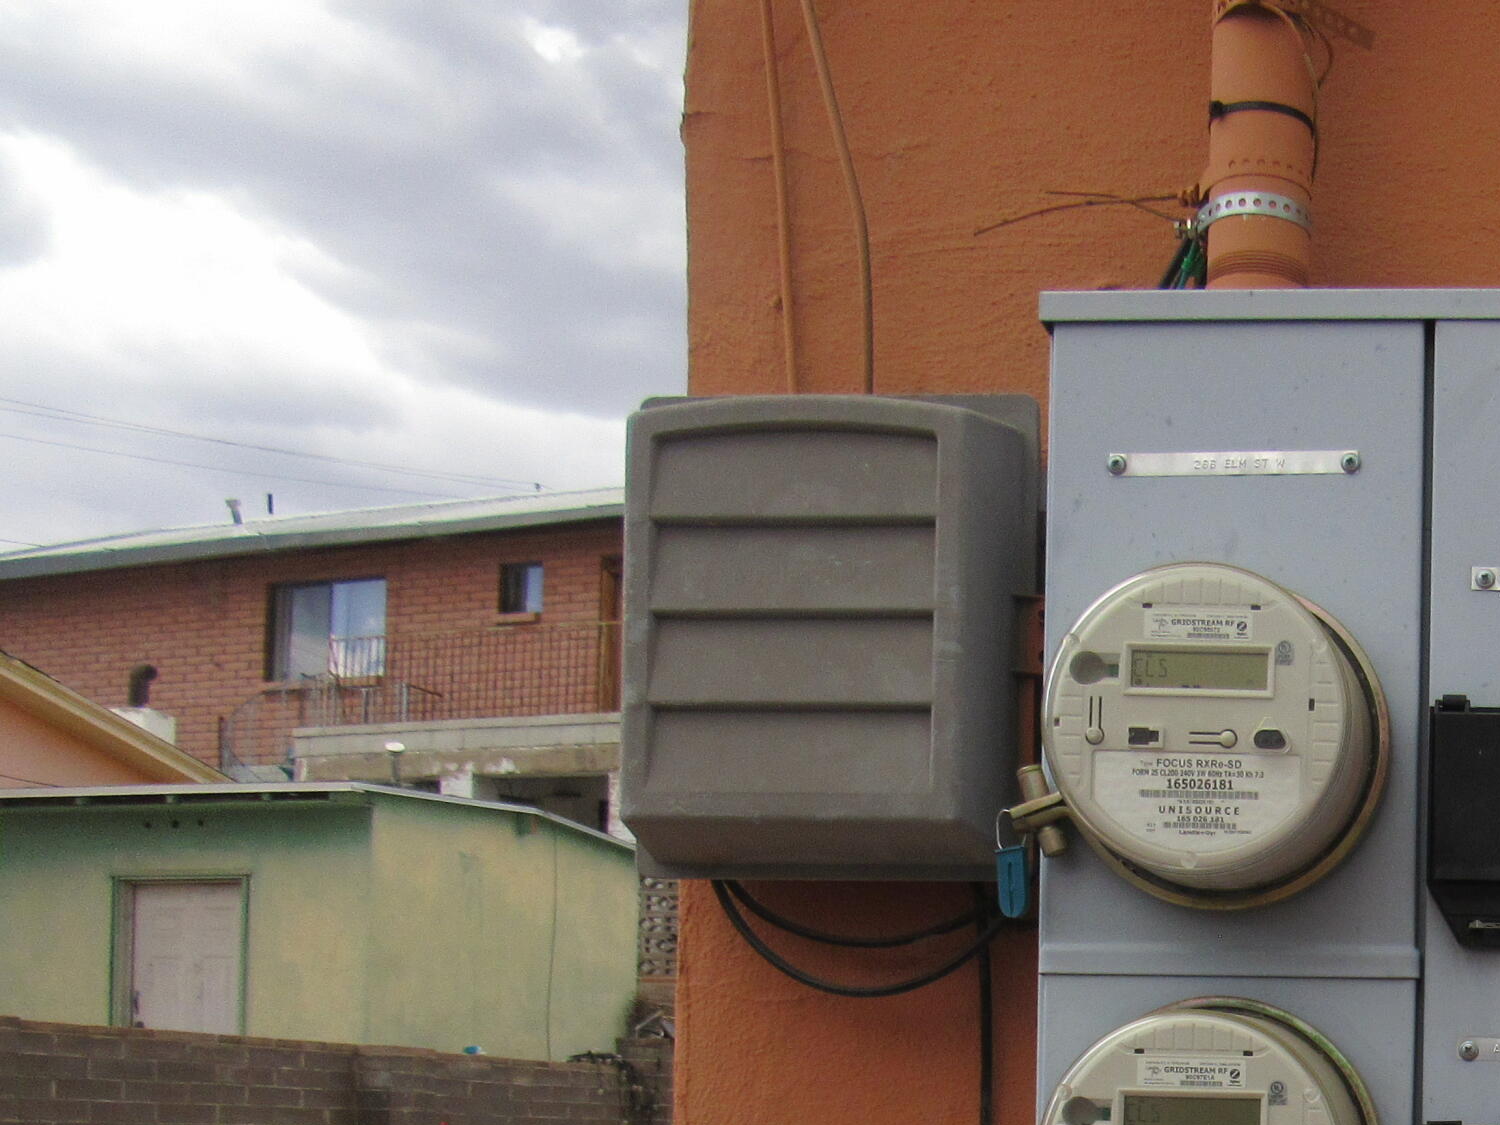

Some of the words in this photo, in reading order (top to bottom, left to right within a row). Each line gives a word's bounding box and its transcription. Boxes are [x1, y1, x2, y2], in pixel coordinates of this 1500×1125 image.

[1224, 458, 1247, 469] ELM
[1254, 458, 1269, 469] ST
[1171, 618, 1223, 626] GRIDSTREAM
[1156, 758, 1193, 768] FOCUS
[1167, 778, 1233, 790] 165026181
[1158, 805, 1240, 815] UNISOURCE
[1164, 1066, 1216, 1074] GRIDSTREAM
